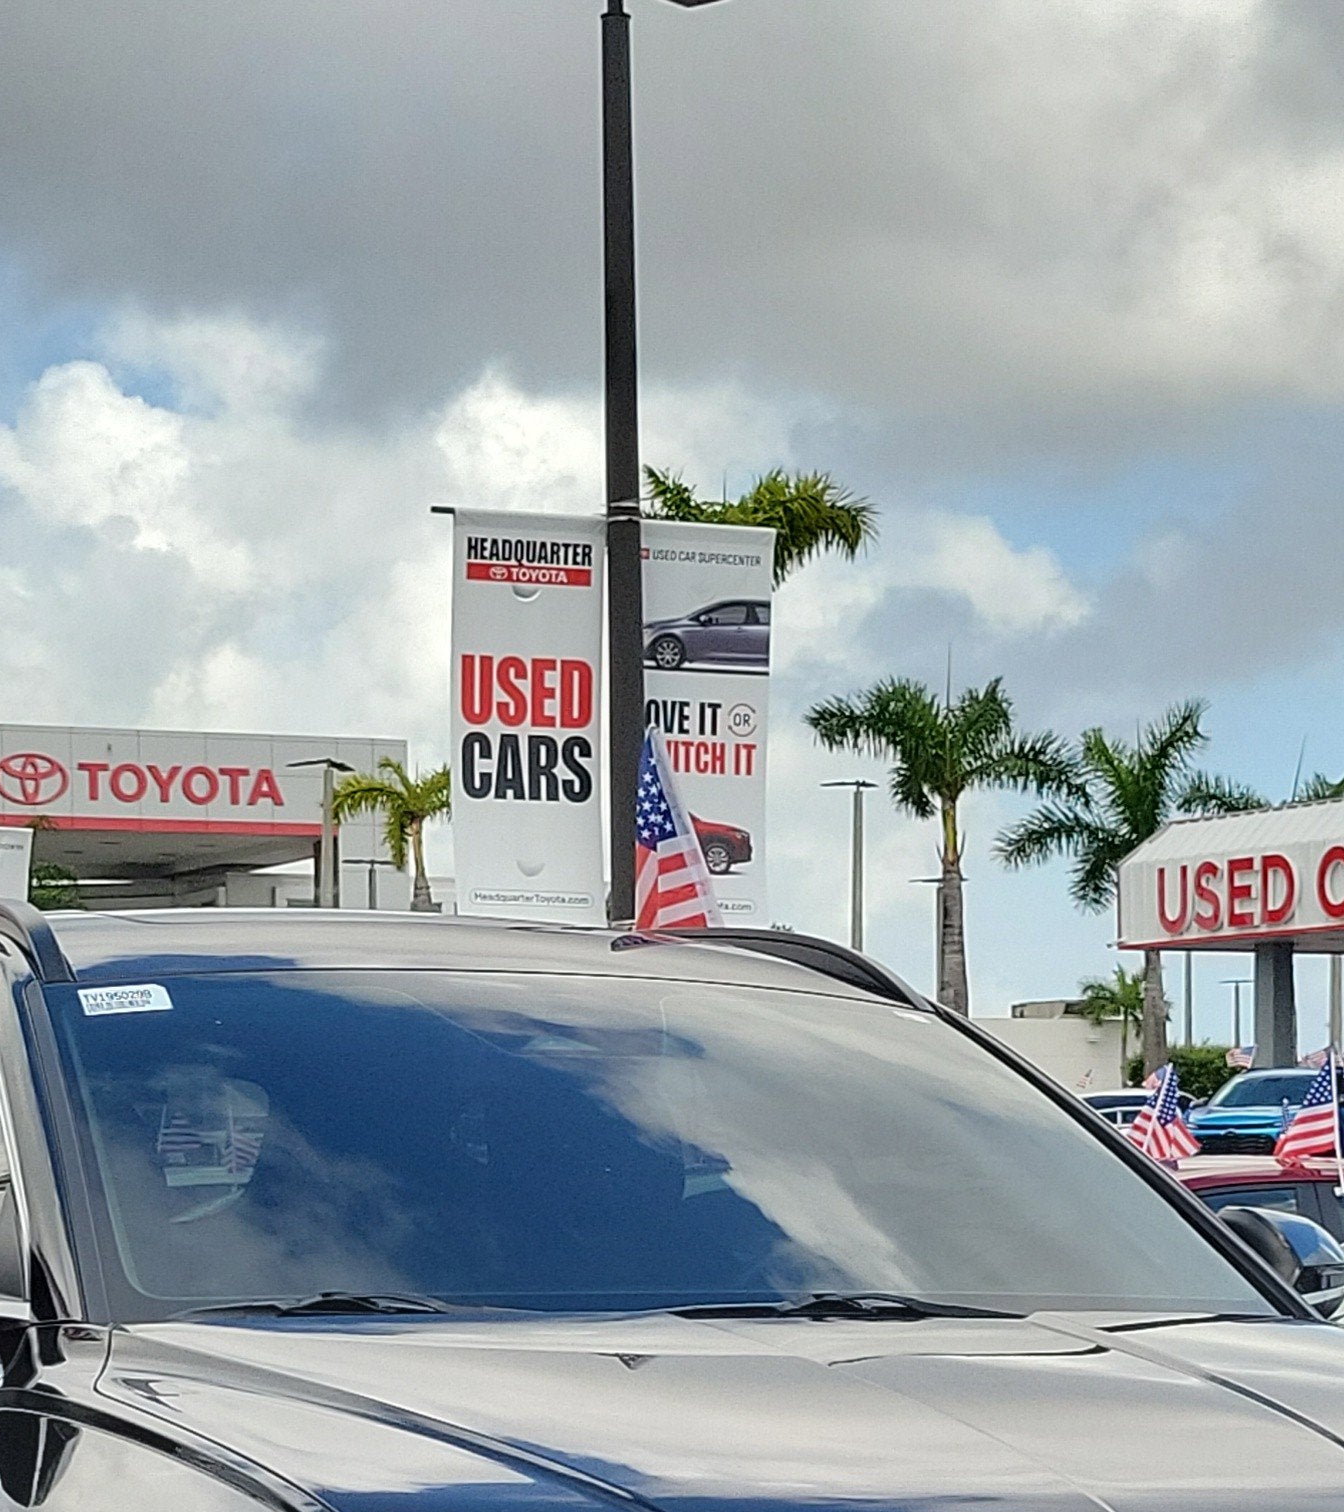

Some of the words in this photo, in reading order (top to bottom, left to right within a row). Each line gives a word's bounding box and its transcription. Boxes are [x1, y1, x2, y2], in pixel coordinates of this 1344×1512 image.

[467, 536, 593, 567] HEADQUARTER
[652, 549, 676, 561] USED
[678, 550, 696, 562] CAR
[697, 552, 762, 567] SUPERCENTER
[511, 568, 568, 584] TOYOTA
[460, 654, 593, 729] USED
[646, 698, 691, 735] OVE
[699, 702, 722, 736] IT
[733, 713, 751, 727] OR
[461, 732, 593, 803] CARS
[666, 739, 726, 775] ITCH
[734, 743, 757, 776] IT
[77, 762, 285, 807] TOYOTA
[1157, 854, 1297, 934] USED
